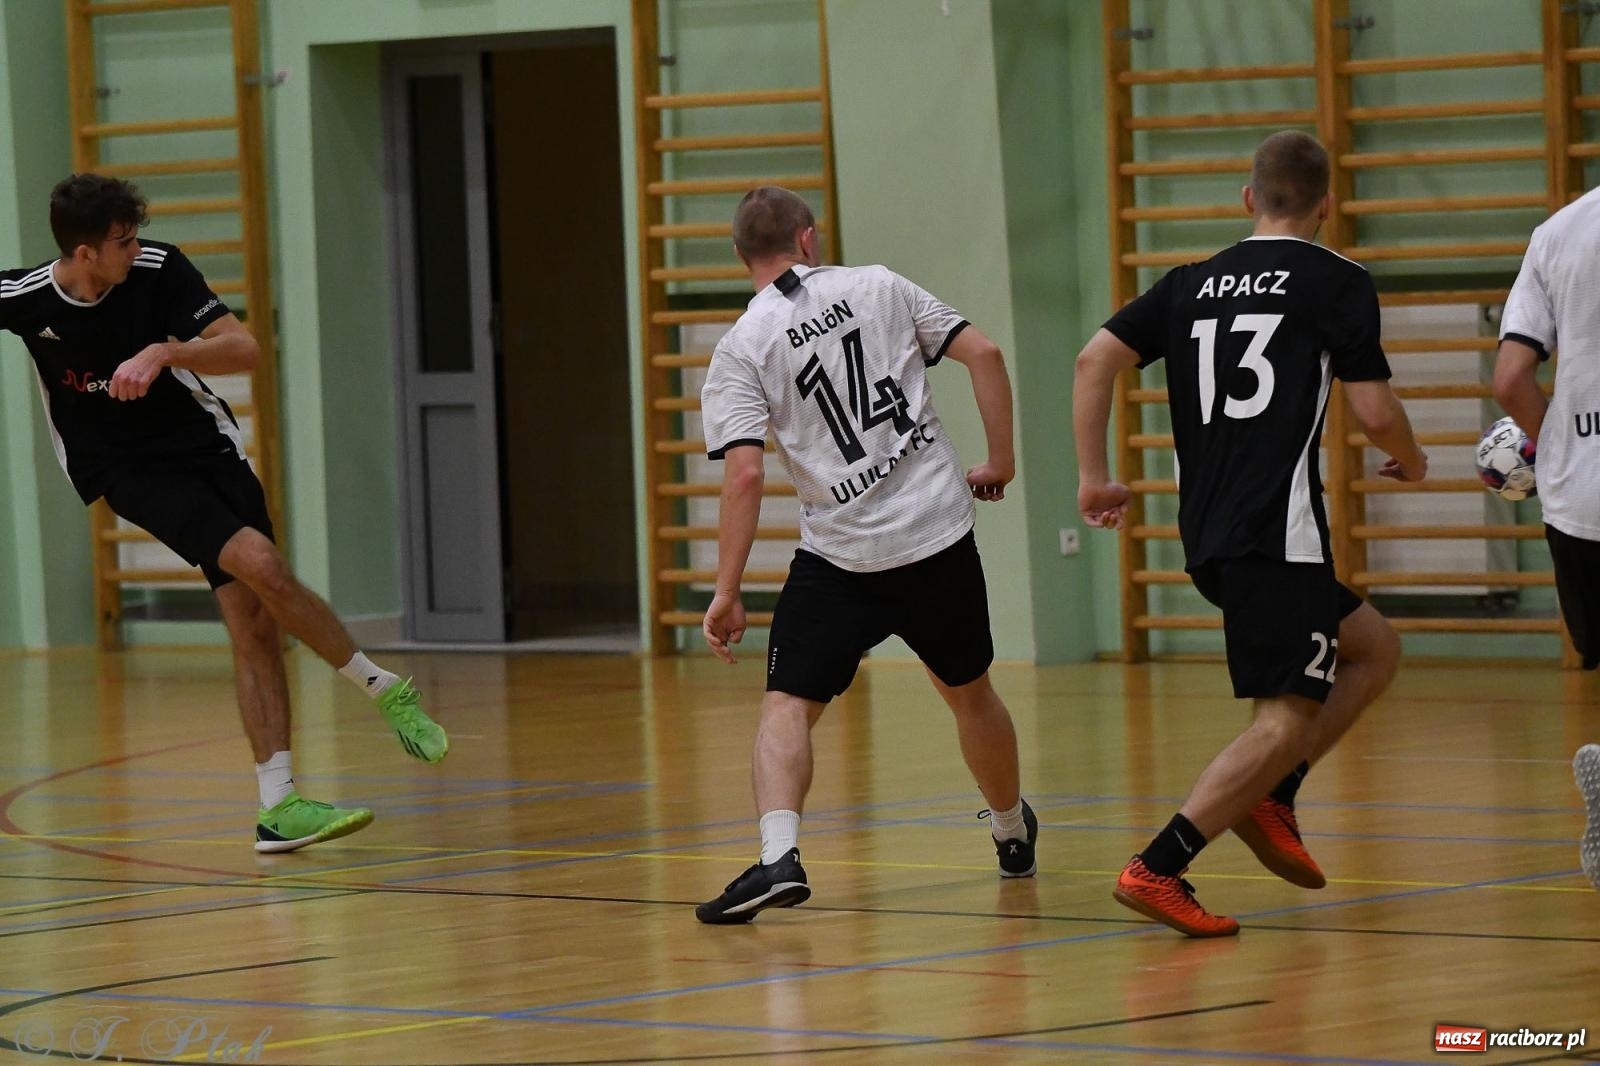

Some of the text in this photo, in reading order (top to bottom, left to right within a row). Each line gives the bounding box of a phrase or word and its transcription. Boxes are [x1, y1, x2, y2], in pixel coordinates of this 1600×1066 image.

[1196, 270, 1290, 299] APACZ
[785, 299, 854, 349] BALöN
[61, 368, 111, 393] Nex
[1190, 313, 1285, 425] 13
[795, 327, 916, 466] 14
[910, 422, 935, 450] FC
